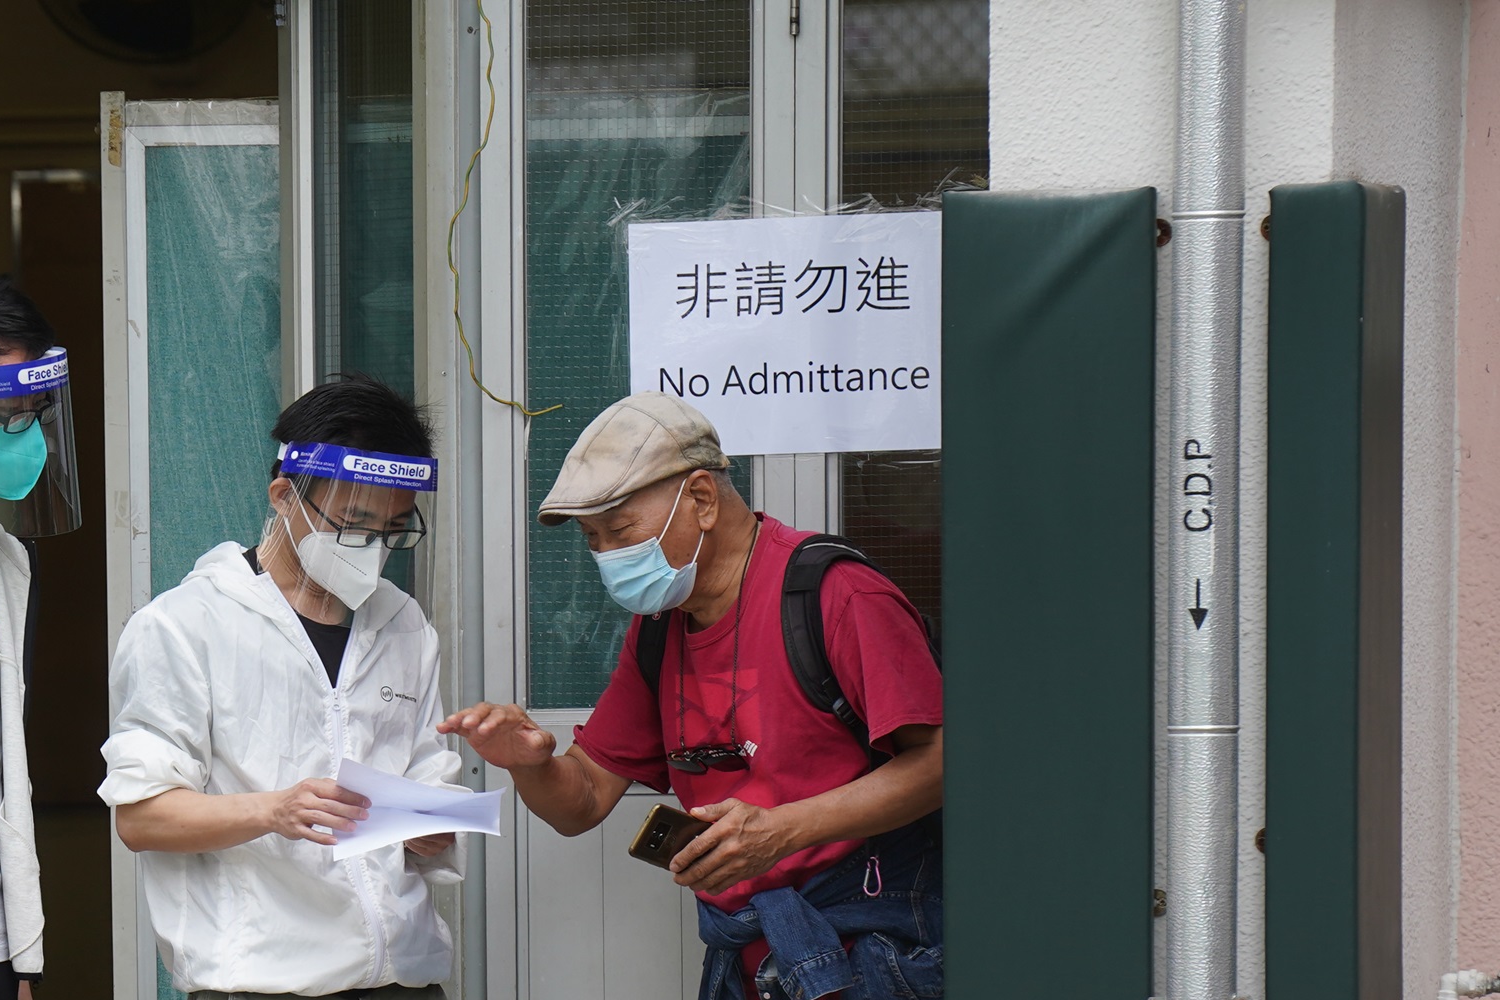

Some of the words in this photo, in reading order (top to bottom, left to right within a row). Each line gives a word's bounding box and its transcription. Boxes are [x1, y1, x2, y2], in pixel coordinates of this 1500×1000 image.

[676, 256, 911, 320] 非請勿進
[27, 369, 51, 381] Face
[659, 367, 711, 397] No
[721, 361, 931, 397] Admittance
[353, 458, 386, 473] Face
[389, 463, 425, 478] Shield
[353, 473, 373, 481] Direct
[373, 475, 395, 485] Splash
[395, 479, 422, 488] Protection
[1183, 438, 1213, 532] C.D.P
